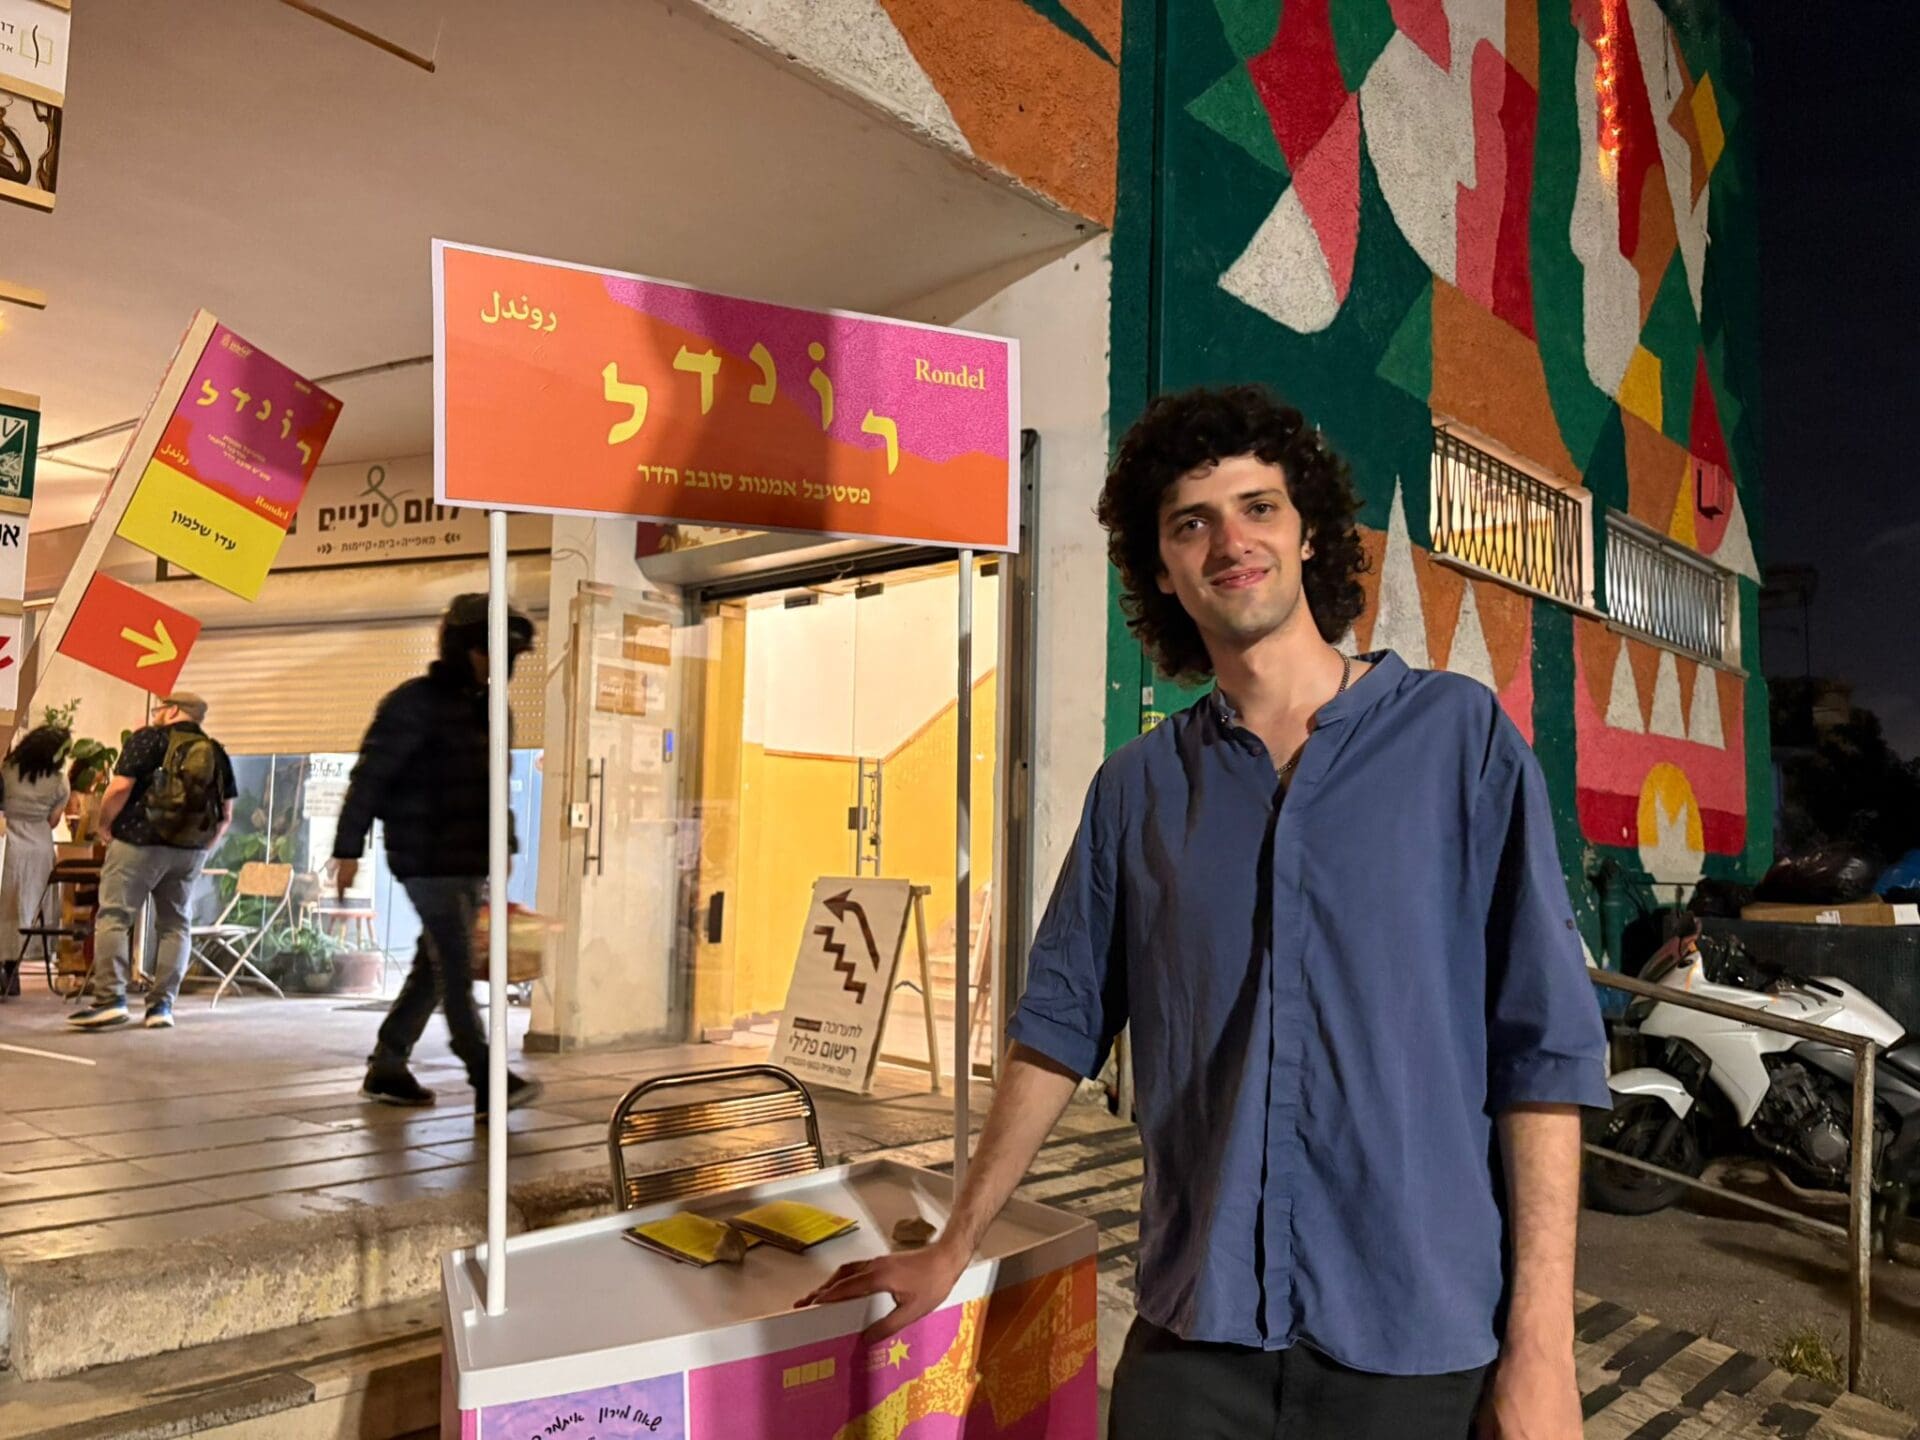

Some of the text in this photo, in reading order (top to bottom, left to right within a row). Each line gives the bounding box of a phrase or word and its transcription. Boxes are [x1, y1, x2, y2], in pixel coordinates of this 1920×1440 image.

[480, 290, 557, 332] روندل
[914, 357, 986, 391] Rondel
[637, 463, 871, 505] פסטיבל אמנות סובב הדר
[171, 509, 212, 537] שלמון
[255, 494, 290, 521] Rondel
[788, 1030, 857, 1064] רישום פלילי
